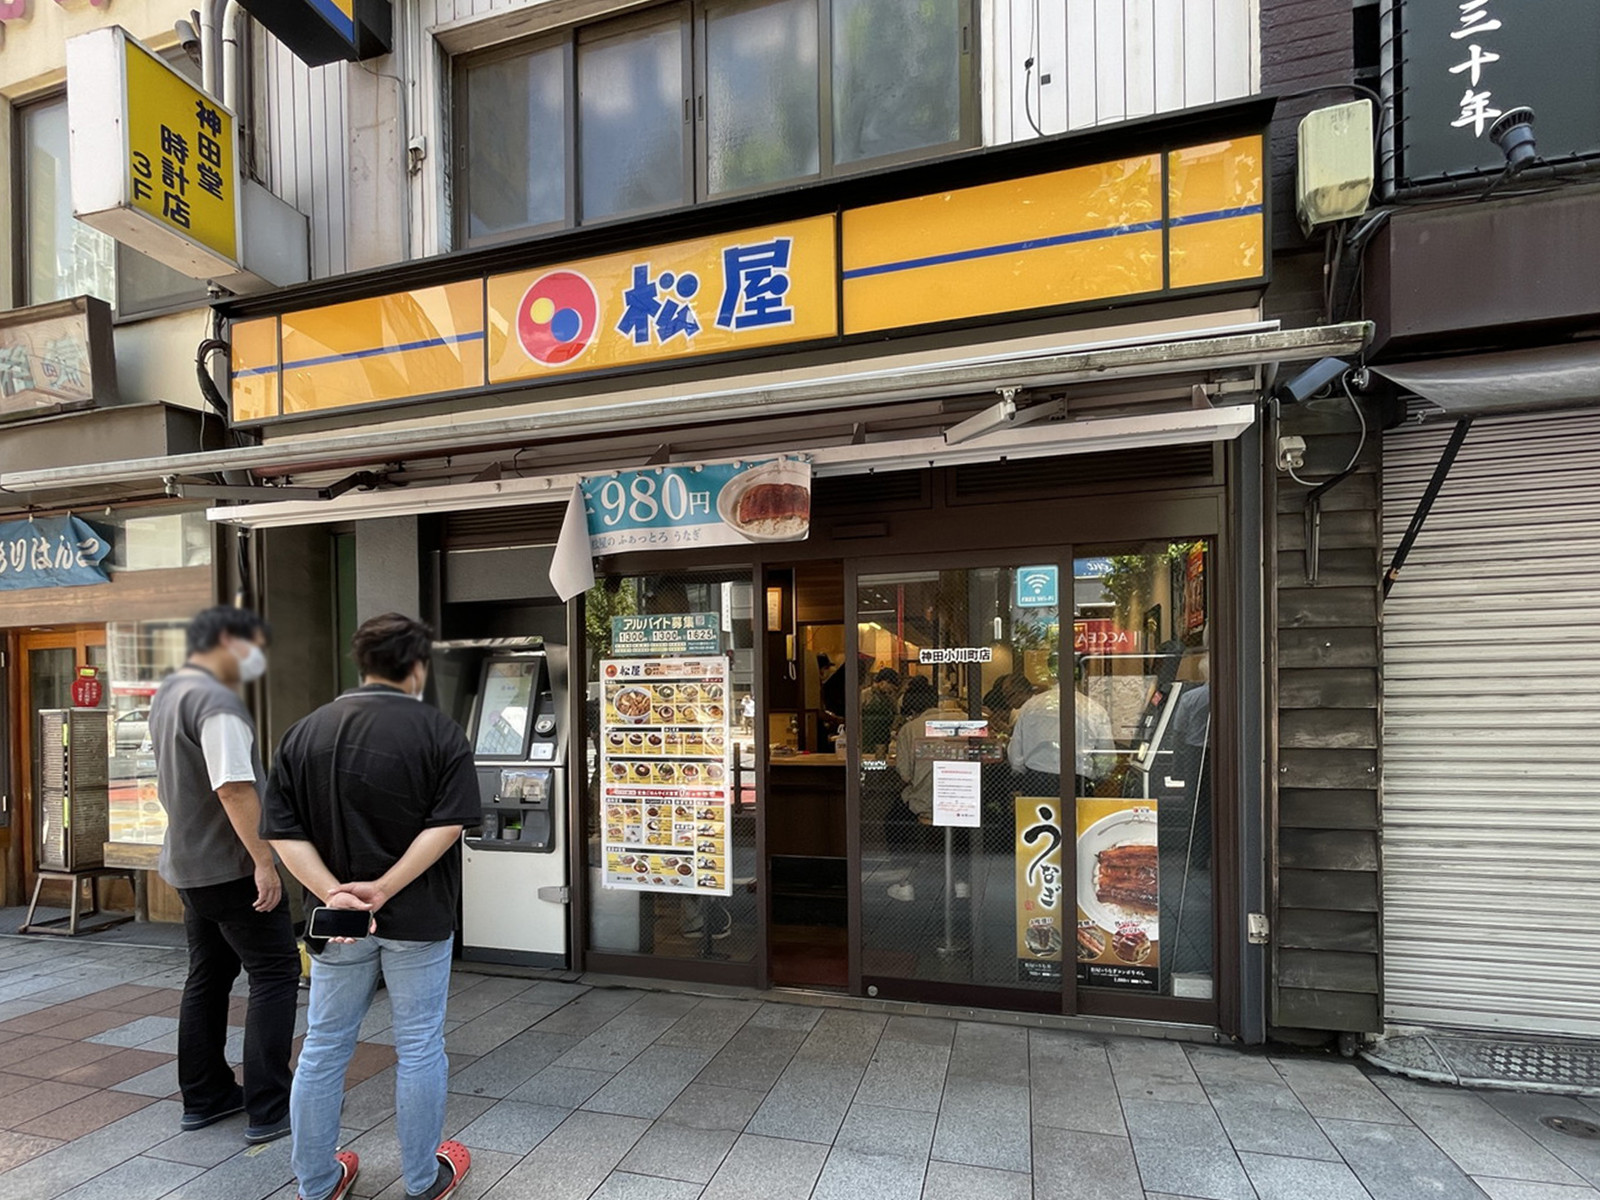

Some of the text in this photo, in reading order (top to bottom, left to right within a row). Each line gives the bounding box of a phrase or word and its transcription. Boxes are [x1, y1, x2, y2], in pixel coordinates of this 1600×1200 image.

[1448, 0, 1502, 138] 三十年
[160, 123, 192, 230] 時計店
[195, 100, 225, 201] 神田堂
[615, 237, 793, 346] 松屋
[619, 664, 641, 677] 松屋
[623, 615, 694, 630] アルバイト募集
[920, 648, 992, 663] 神田小川町店
[1024, 806, 1061, 907] うなぎ
